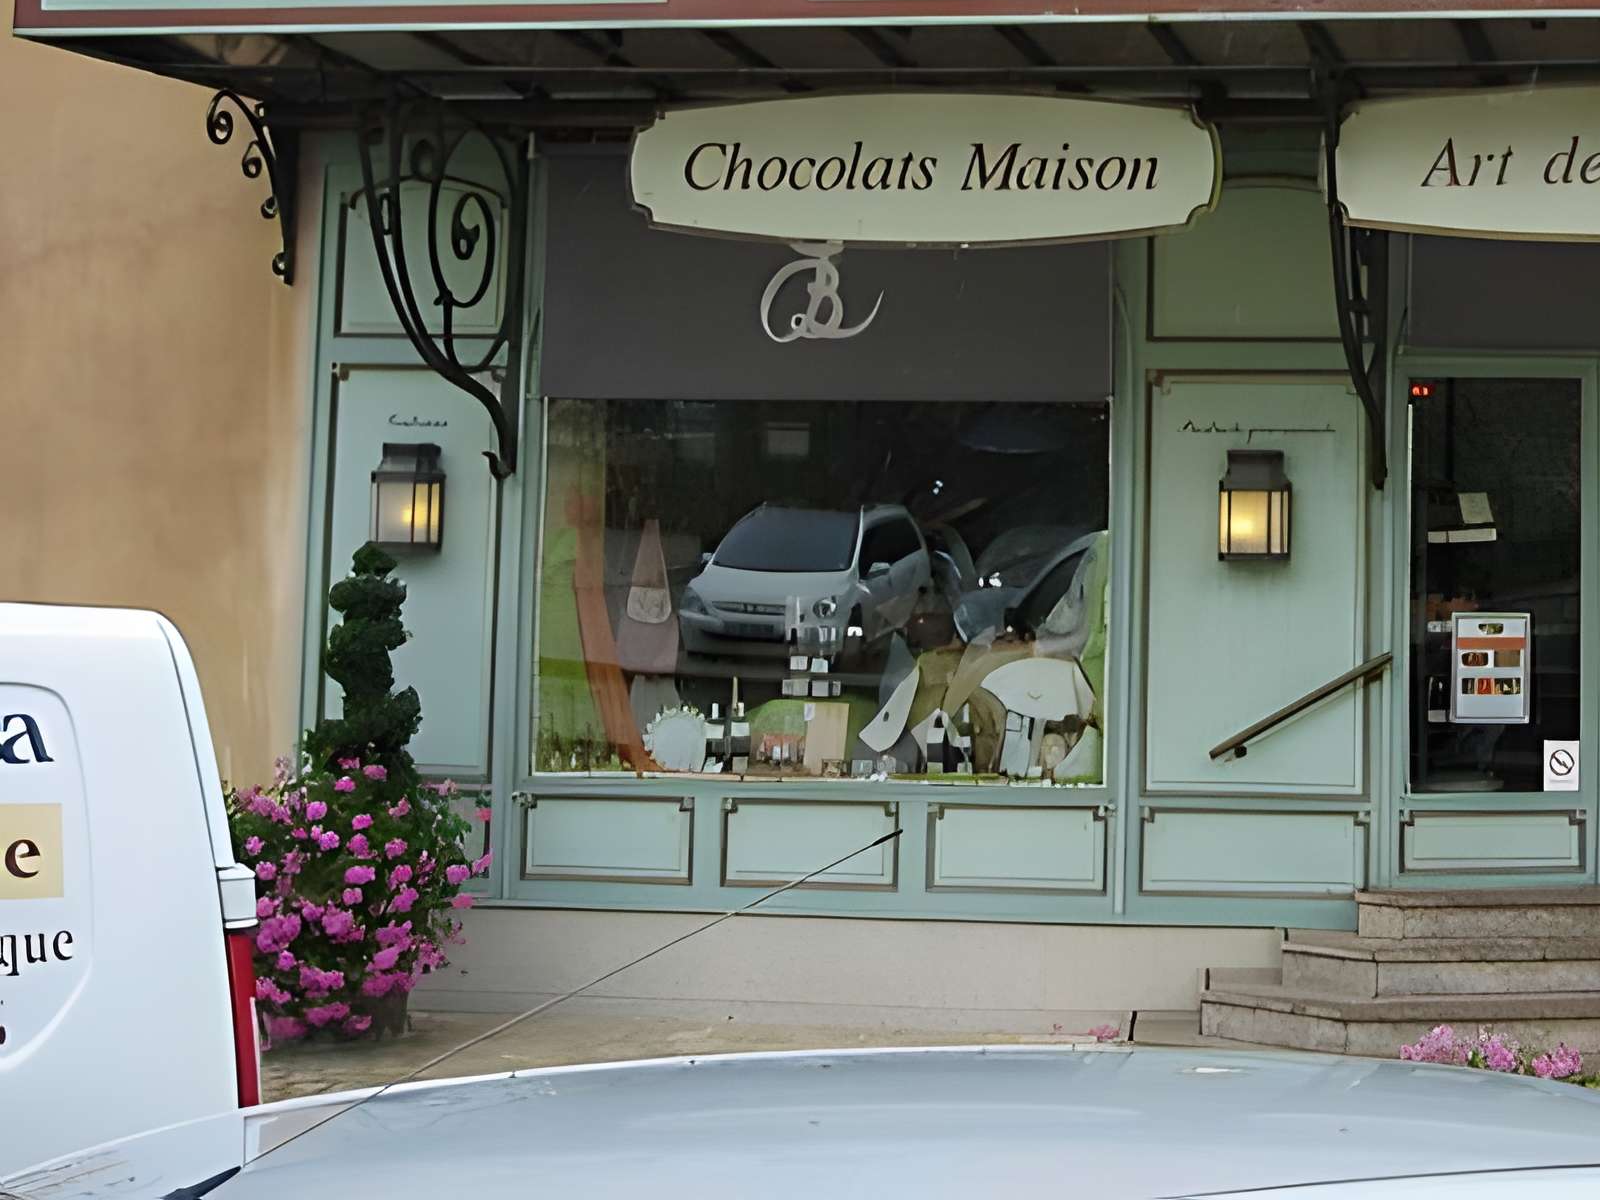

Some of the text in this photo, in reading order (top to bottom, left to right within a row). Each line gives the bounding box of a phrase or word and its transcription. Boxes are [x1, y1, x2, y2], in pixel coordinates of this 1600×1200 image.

[683, 141, 1160, 191] Chocolats Maison
[1419, 136, 1513, 188] Art
